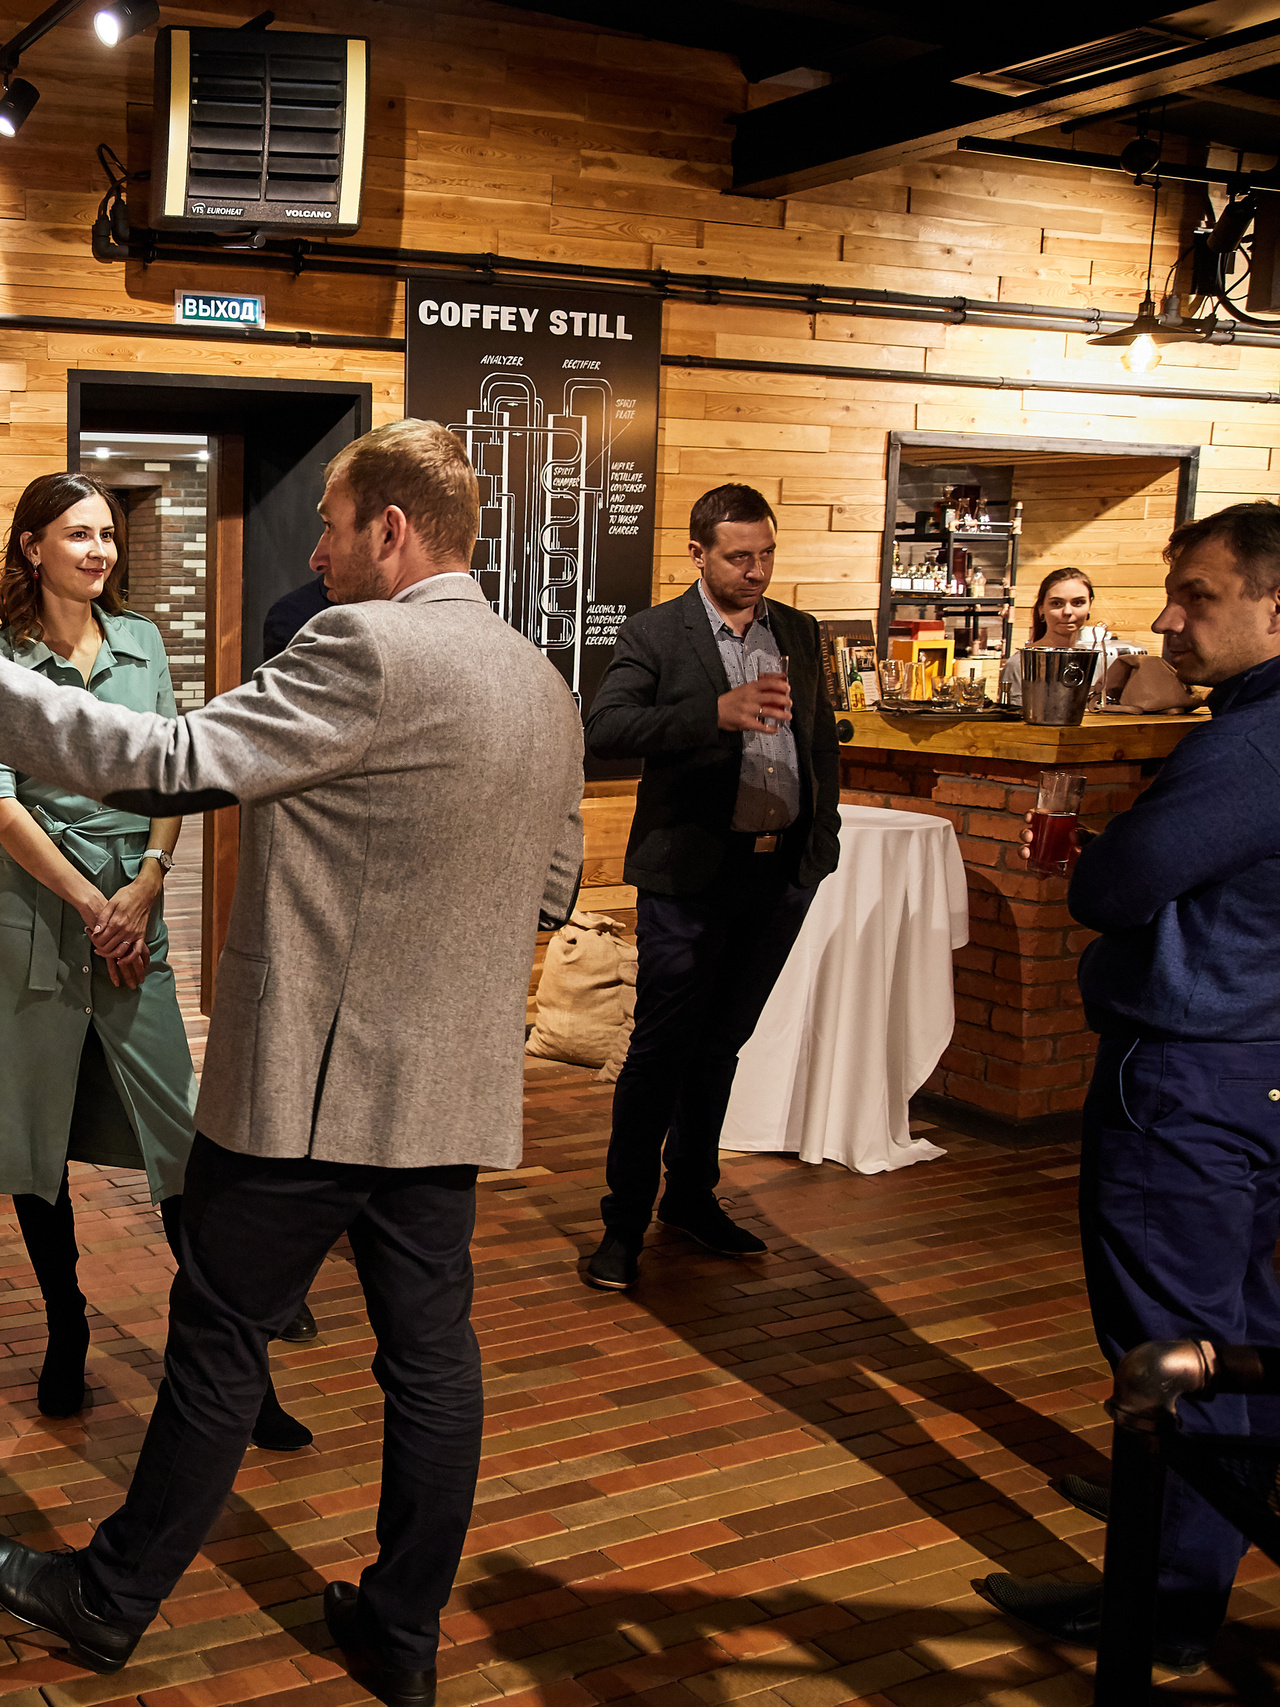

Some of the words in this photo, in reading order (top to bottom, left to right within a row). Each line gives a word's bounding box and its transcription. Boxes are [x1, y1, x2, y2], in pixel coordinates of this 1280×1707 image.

[207, 207, 243, 216] EUROHEAT
[285, 209, 332, 219] VOLCANO
[184, 298, 255, 322] ВЫХОД
[418, 299, 539, 333] COFFEY
[549, 309, 633, 341] STILL
[480, 355, 524, 367] ANALYZER
[561, 359, 602, 371] RECTIFIER
[610, 493, 626, 503] AND
[586, 604, 616, 614] ALCOHOL
[617, 604, 627, 614] TO
[585, 625, 602, 635] AND
